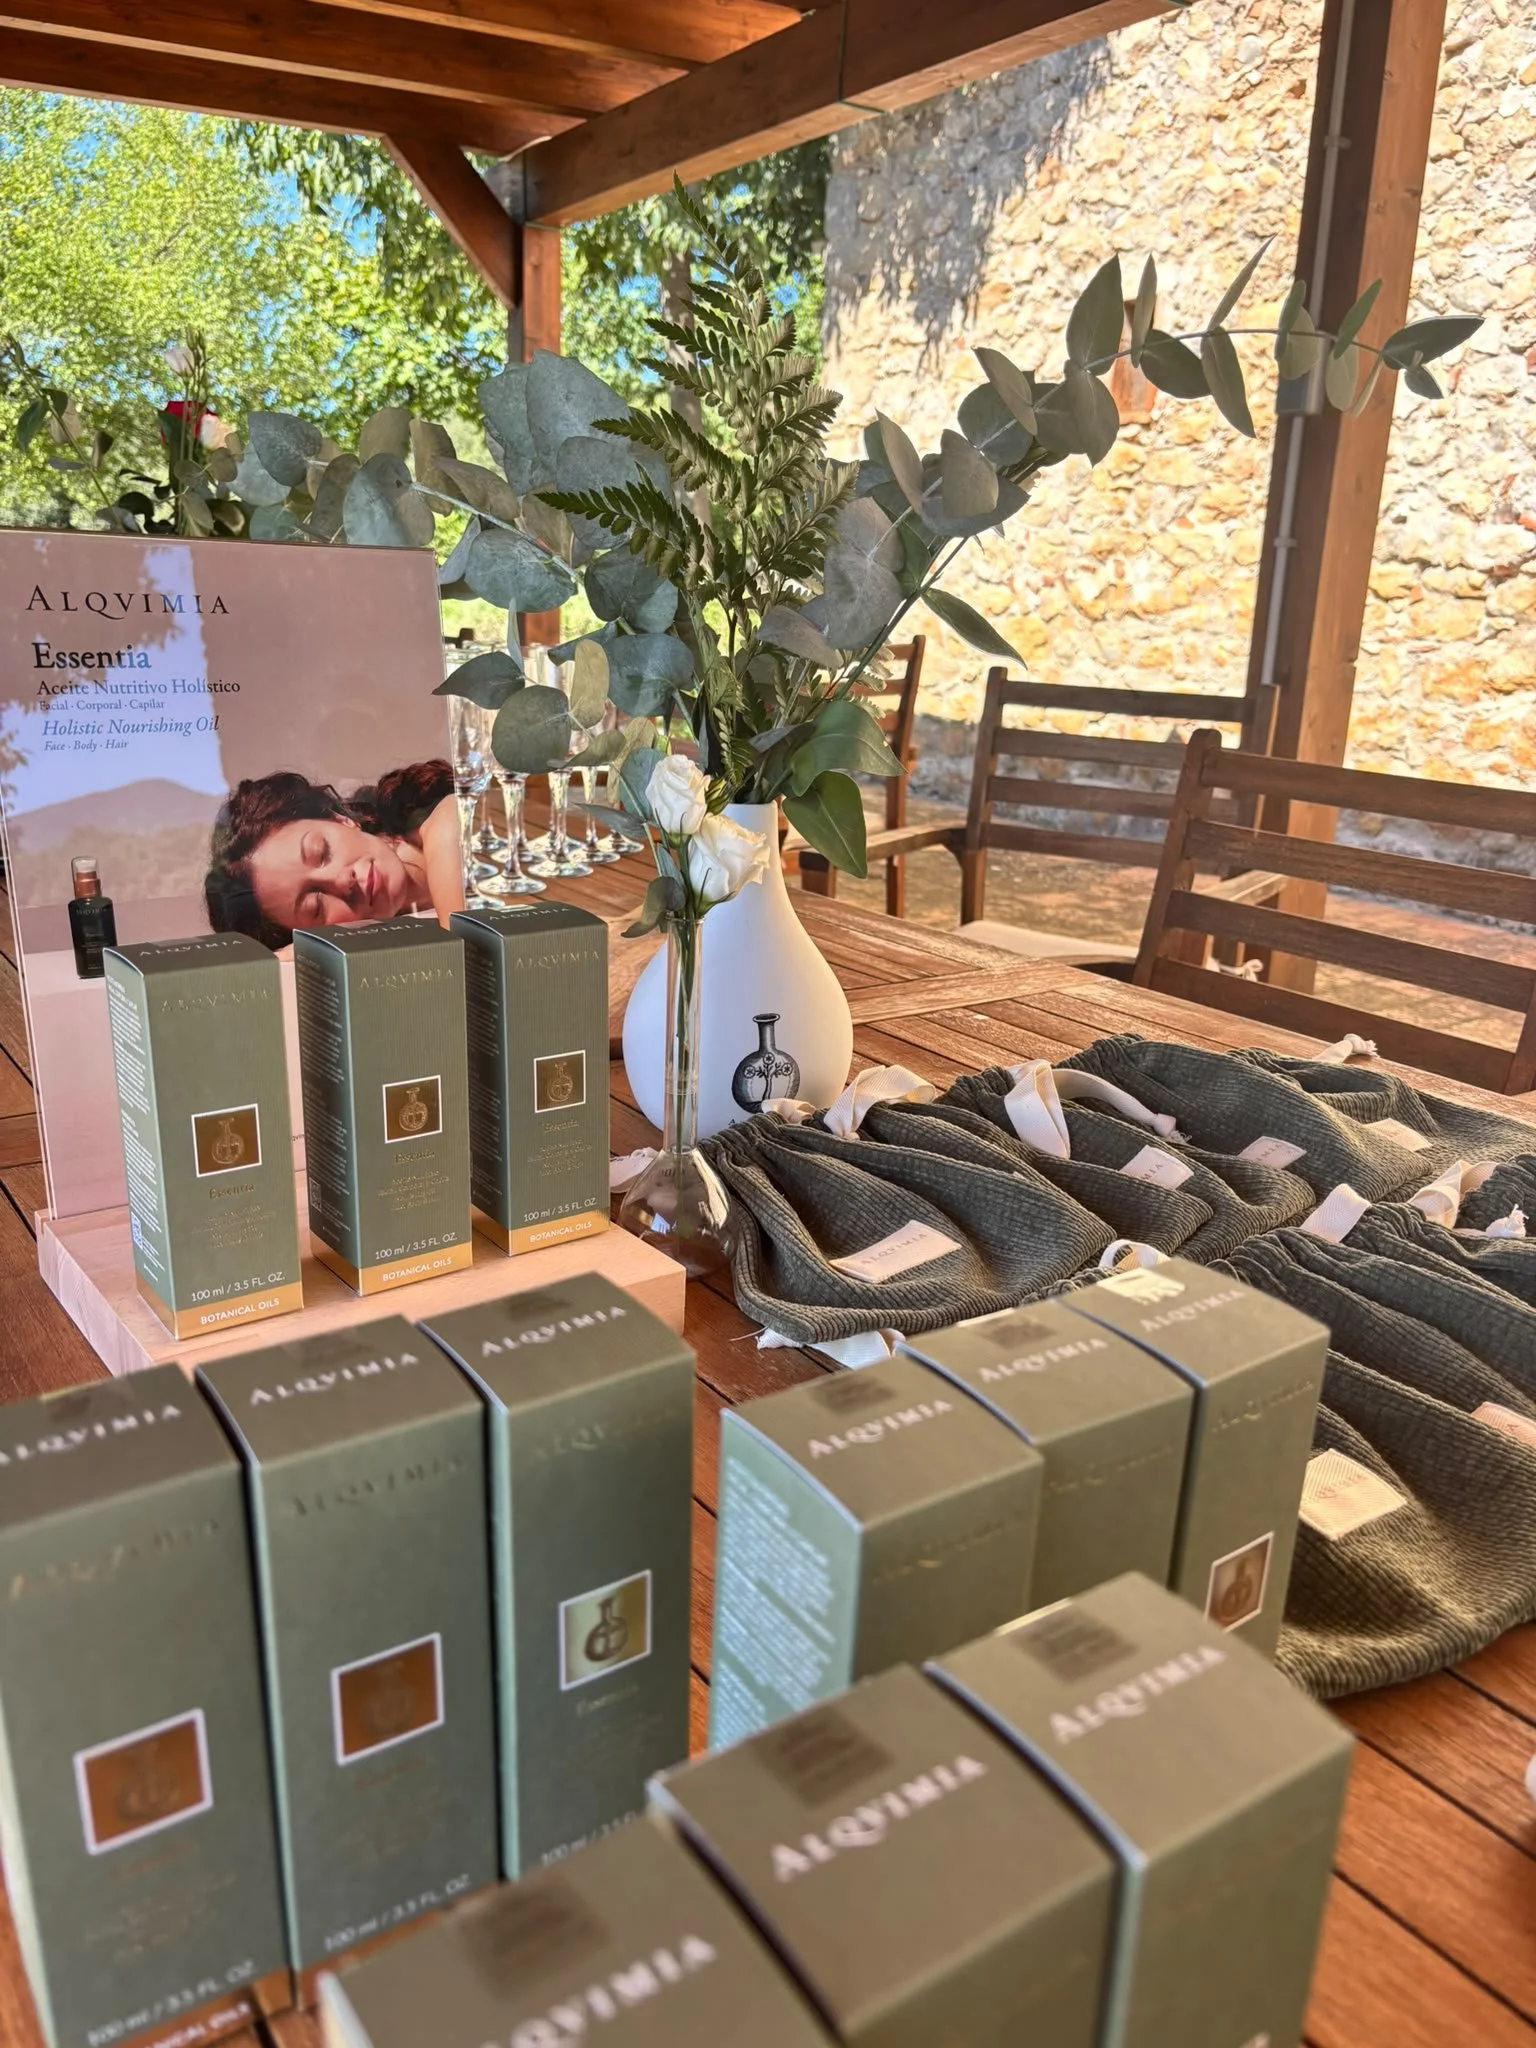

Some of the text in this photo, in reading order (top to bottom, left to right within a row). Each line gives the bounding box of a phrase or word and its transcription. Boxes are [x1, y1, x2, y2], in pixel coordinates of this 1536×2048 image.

[25, 585, 229, 619] ALQVIMIA
[31, 642, 152, 669] Essentia
[37, 681, 89, 695] Aceite
[94, 680, 168, 695] Nutritivo
[40, 699, 165, 713] Facial Corporal Capilar
[42, 715, 221, 737] Holistic Nourishing Oil
[44, 739, 129, 752] Face Body Hair
[489, 907, 571, 921] ALQVIMIA
[334, 924, 424, 938] ALQVIMIA
[140, 940, 242, 957] ALQVIMIA
[515, 951, 601, 970] ALQVIMIA
[360, 968, 455, 992] ALQVIMIA
[523, 1210, 540, 1222] 100
[540, 1207, 551, 1218] ml
[558, 1203, 570, 1214] 3.5
[530, 1221, 593, 1243] BOTANICAL OILS
[375, 1248, 392, 1261] 100
[394, 1244, 405, 1257] ml
[413, 1239, 427, 1251] 3.5
[382, 1257, 453, 1282] BOTANICAL OILS
[191, 1290, 211, 1303] 100
[212, 1285, 224, 1298] ml
[234, 1279, 249, 1292] 3.5
[200, 1297, 280, 1325] BOTANICAL OILS
[1140, 1288, 1247, 1333] ALQVIMIA
[482, 1305, 627, 1358] ALQVIMIA
[978, 1337, 1109, 1384] ALQVIMIA
[251, 1352, 418, 1406] ALQVIMIA
[808, 1399, 954, 1460] ALQVIMIA
[1048, 1644, 1229, 1746] ALQVIMIA
[768, 1754, 988, 1884] ALQVIMIA
[479, 1933, 718, 2048] QVIMIA
